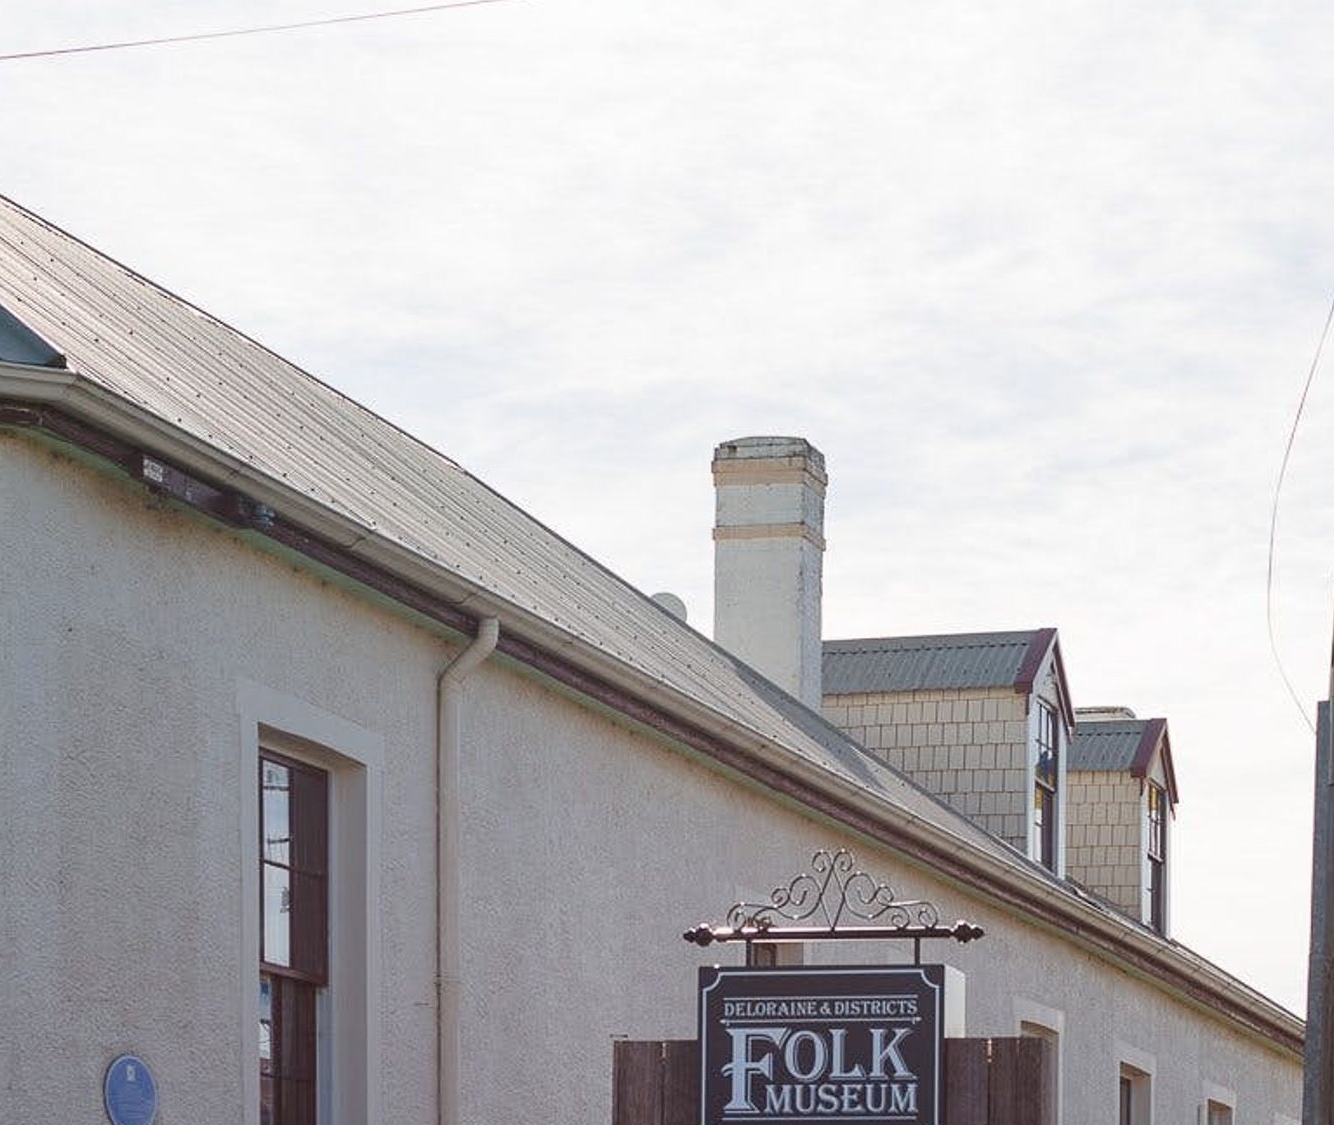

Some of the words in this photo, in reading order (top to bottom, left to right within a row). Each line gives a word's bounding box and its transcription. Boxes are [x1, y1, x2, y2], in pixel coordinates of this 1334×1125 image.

[723, 1000, 816, 1017] DELORAINE
[819, 1001, 832, 1015] &
[834, 1000, 918, 1015] DISTRICTS
[721, 1027, 918, 1114] FOLK
[763, 1083, 919, 1114] MUSEUM
